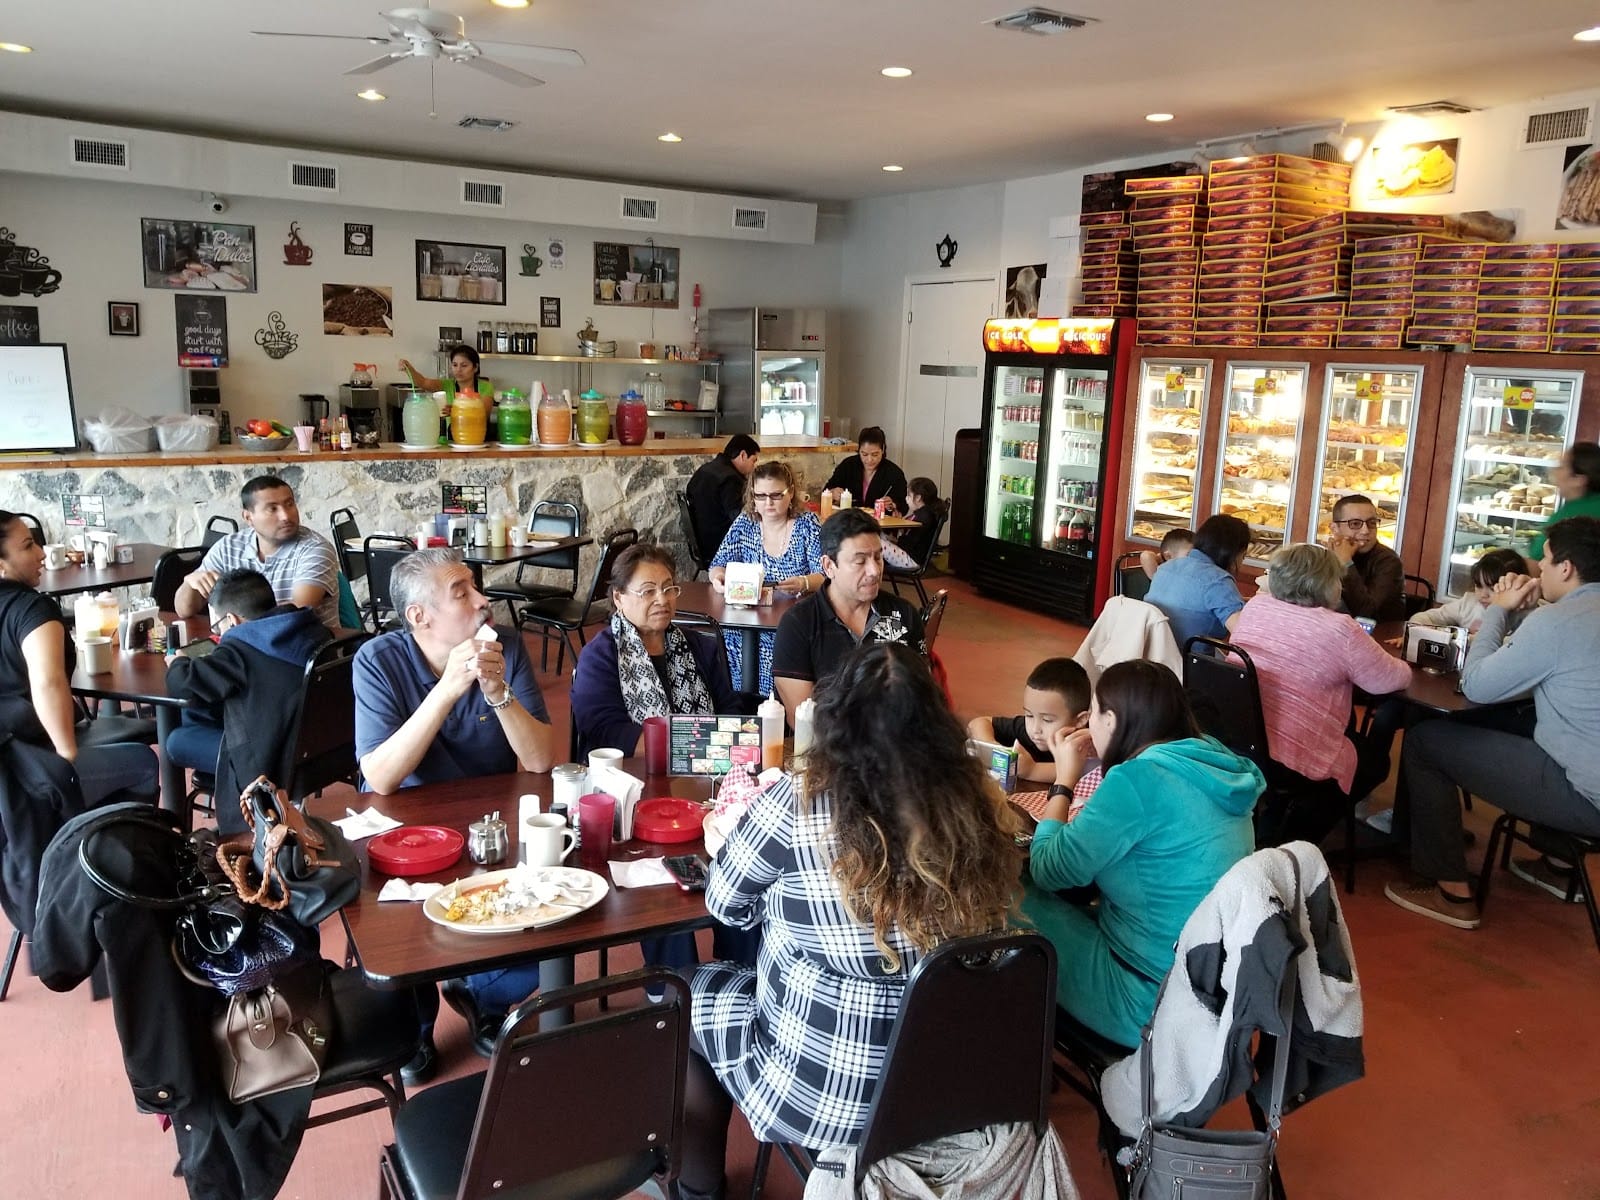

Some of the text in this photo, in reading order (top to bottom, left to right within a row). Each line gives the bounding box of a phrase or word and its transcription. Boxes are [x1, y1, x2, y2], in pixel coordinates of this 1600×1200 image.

[212, 229, 240, 246] Pan
[213, 246, 252, 263] Dulce
[0, 318, 30, 338] offee
[184, 324, 222, 337] good days
[184, 336, 222, 346] start with
[987, 331, 1000, 340] ICE
[187, 346, 221, 354] coffee
[1430, 644, 1439, 654] 10
